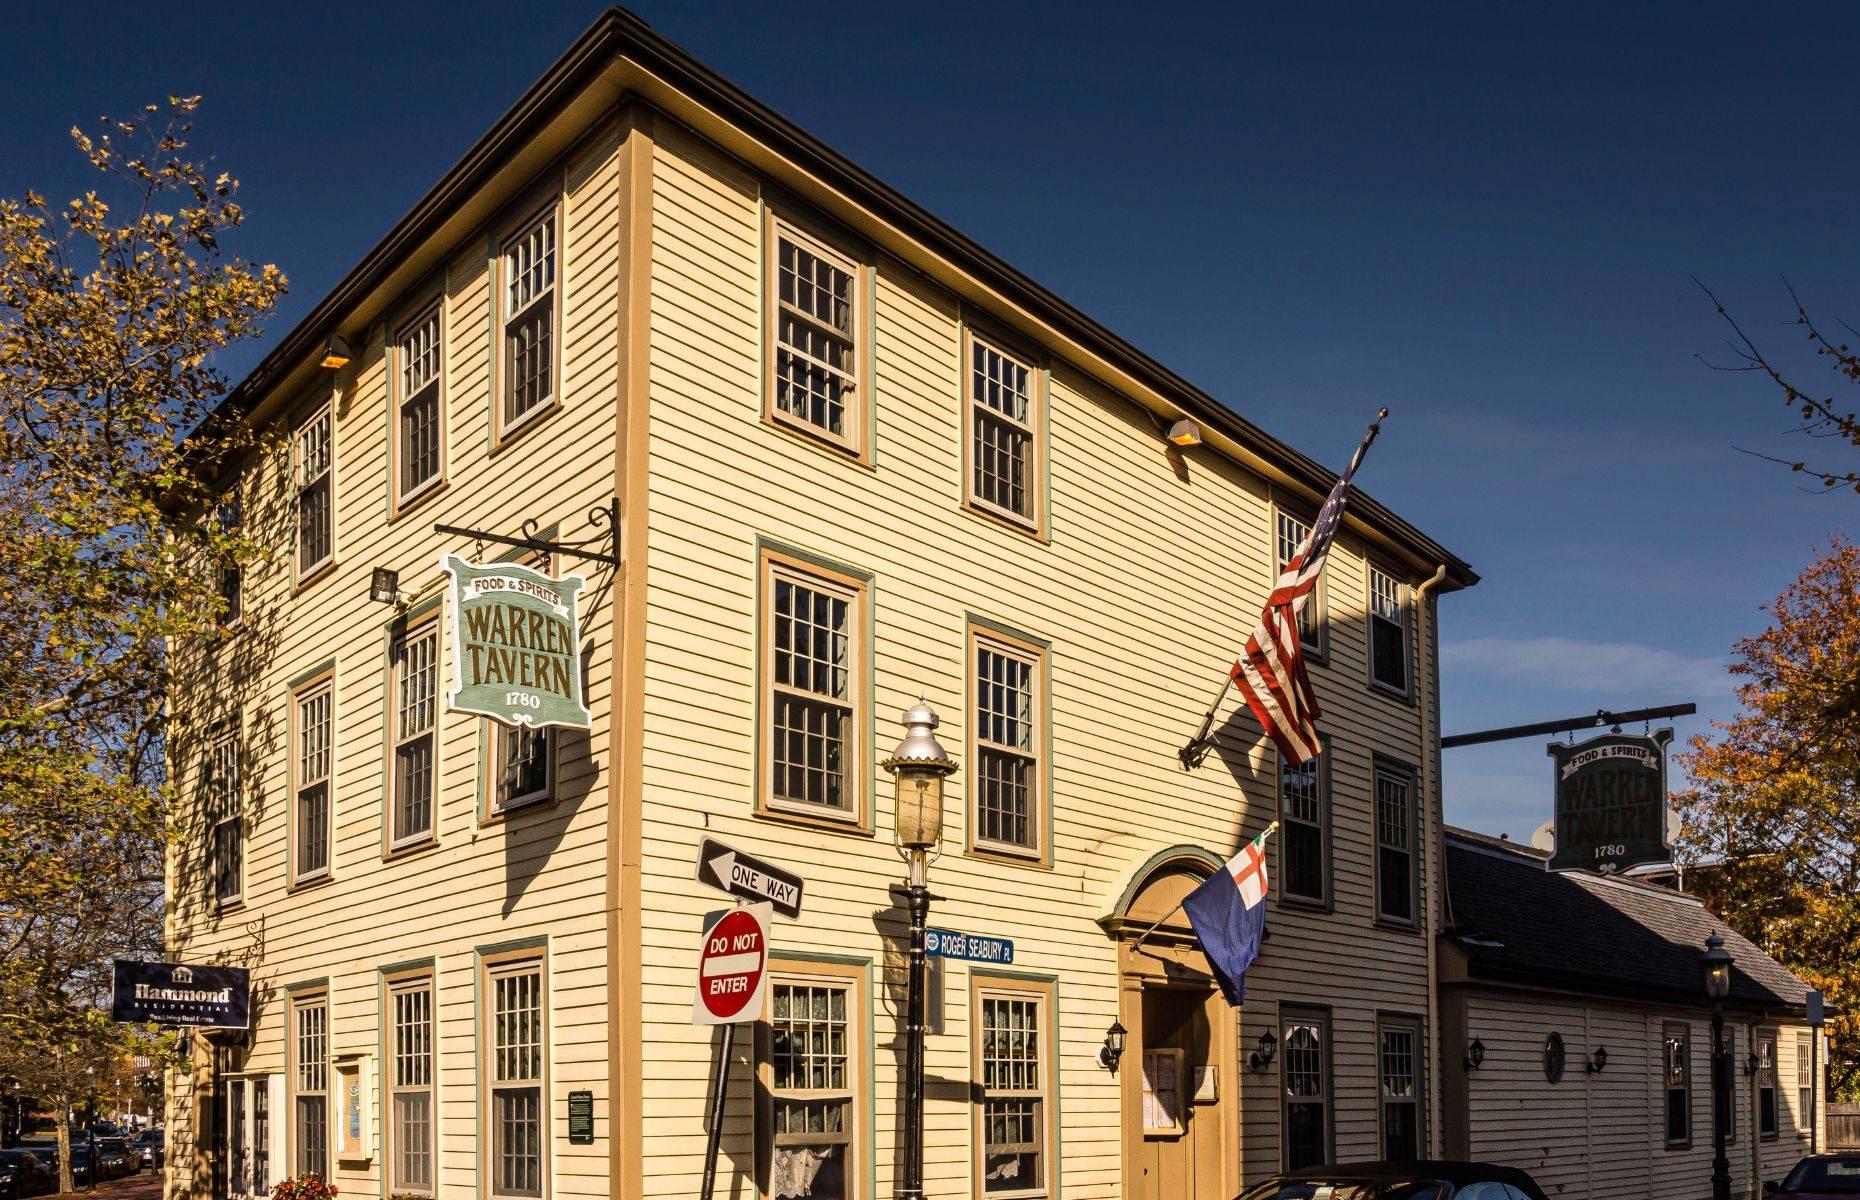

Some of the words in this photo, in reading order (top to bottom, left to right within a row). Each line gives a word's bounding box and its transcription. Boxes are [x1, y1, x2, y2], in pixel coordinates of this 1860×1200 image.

[474, 578, 504, 592] FOOD
[508, 580, 516, 589] &
[518, 580, 560, 606] SPIRITS
[464, 605, 573, 656] WARREN
[466, 643, 571, 699] TAVERN
[505, 692, 540, 709] 1780
[1572, 749, 1598, 767] FOOD
[1602, 748, 1608, 757] &
[1611, 746, 1647, 758] SPIRITS
[1595, 844, 1625, 859] 1780
[732, 865, 759, 890] ONE
[767, 878, 794, 903] WAY
[711, 937, 728, 954] DO
[733, 933, 758, 951] NOT
[941, 934, 966, 957] ROGER
[968, 938, 1003, 960] SEABURY
[1004, 947, 1011, 962] PL
[134, 983, 231, 1003] Hammond
[710, 976, 748, 995] ENTER
[134, 1002, 229, 1013] RESIDENTIAL
